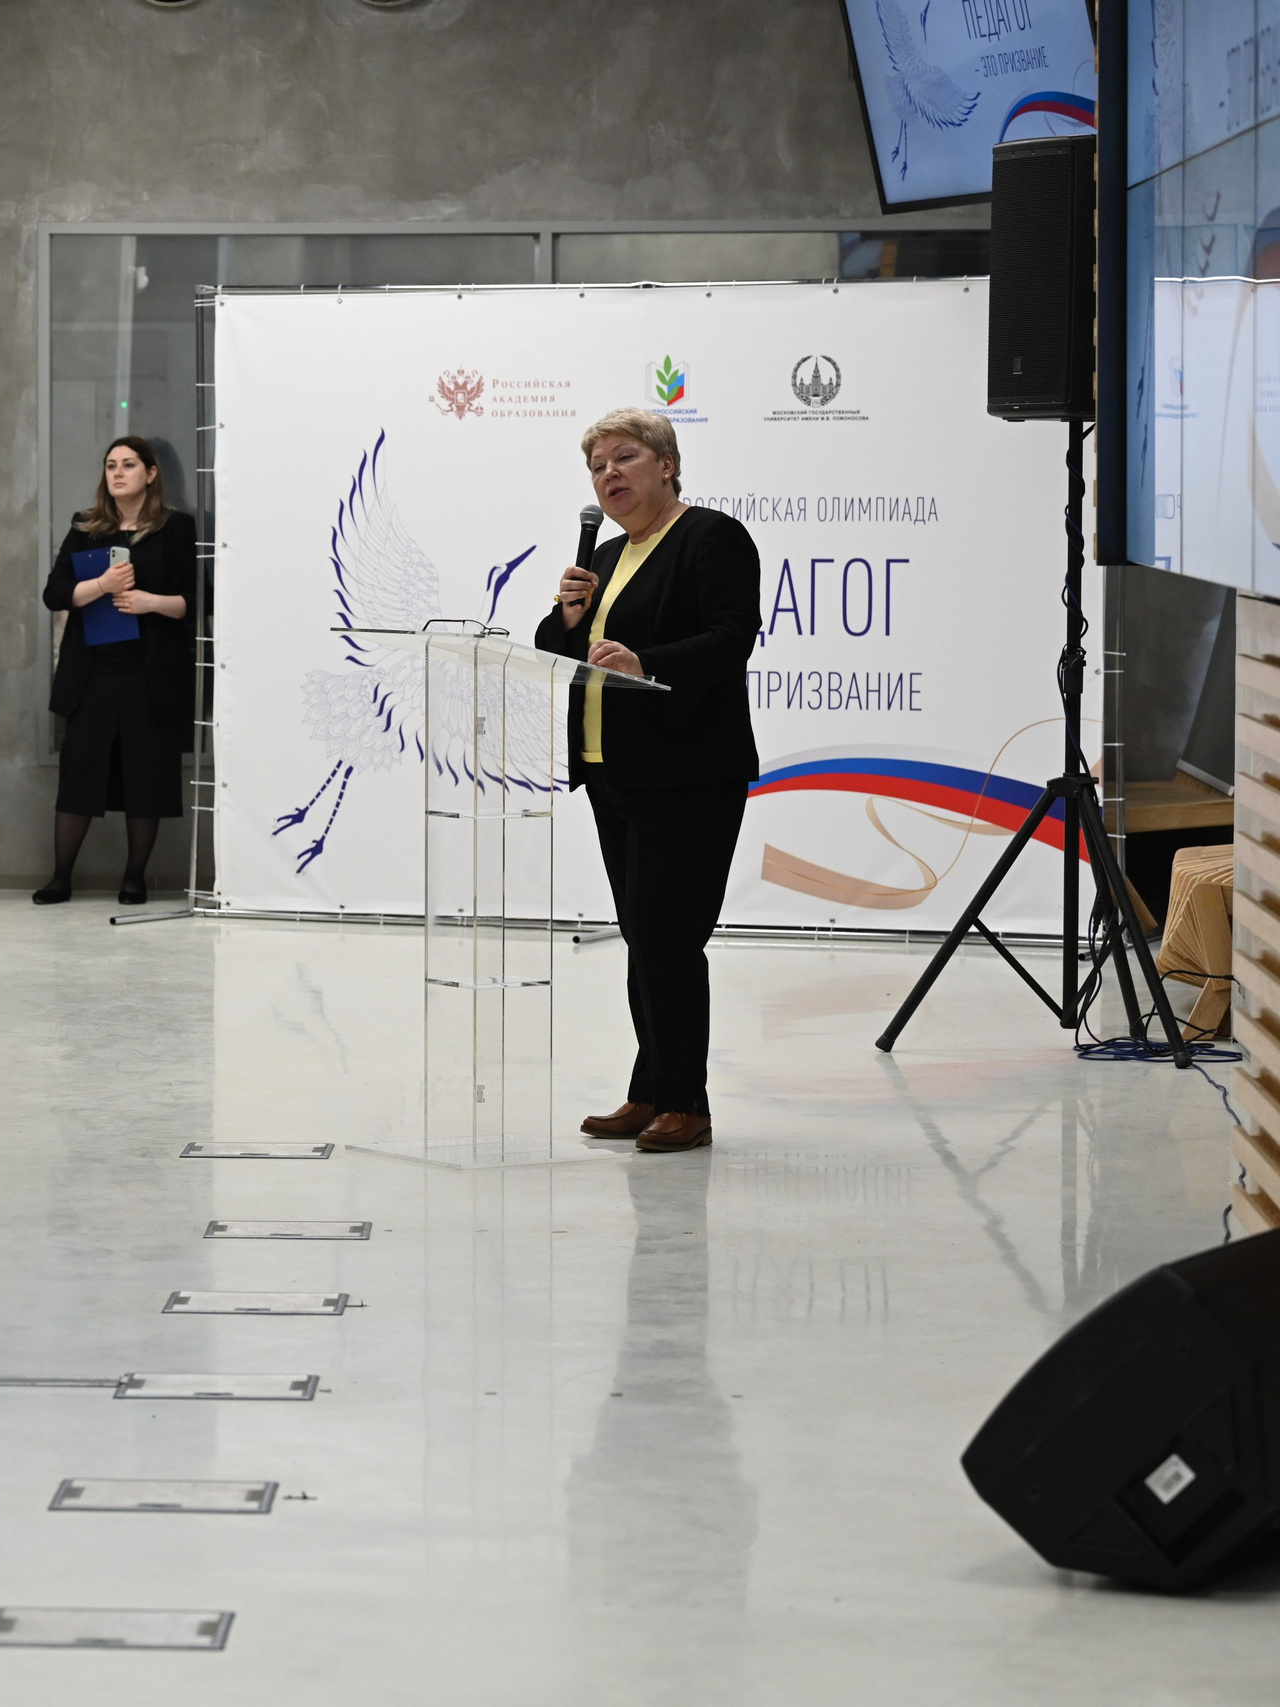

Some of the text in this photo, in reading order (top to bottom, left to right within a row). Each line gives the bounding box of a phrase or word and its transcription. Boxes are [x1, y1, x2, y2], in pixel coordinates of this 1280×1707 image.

[980, 54, 998, 78] ЭТО
[998, 46, 1049, 75] ПРИЗВАНИЕ
[491, 409, 576, 418] ОБРАЗОВАНИЯ
[492, 395, 555, 403] АКАДЕМИЯ
[816, 496, 939, 526] ОЛИМПИАДА
[756, 557, 910, 648] АГОГ
[746, 671, 923, 712] ПРИЗВАНИЕ
